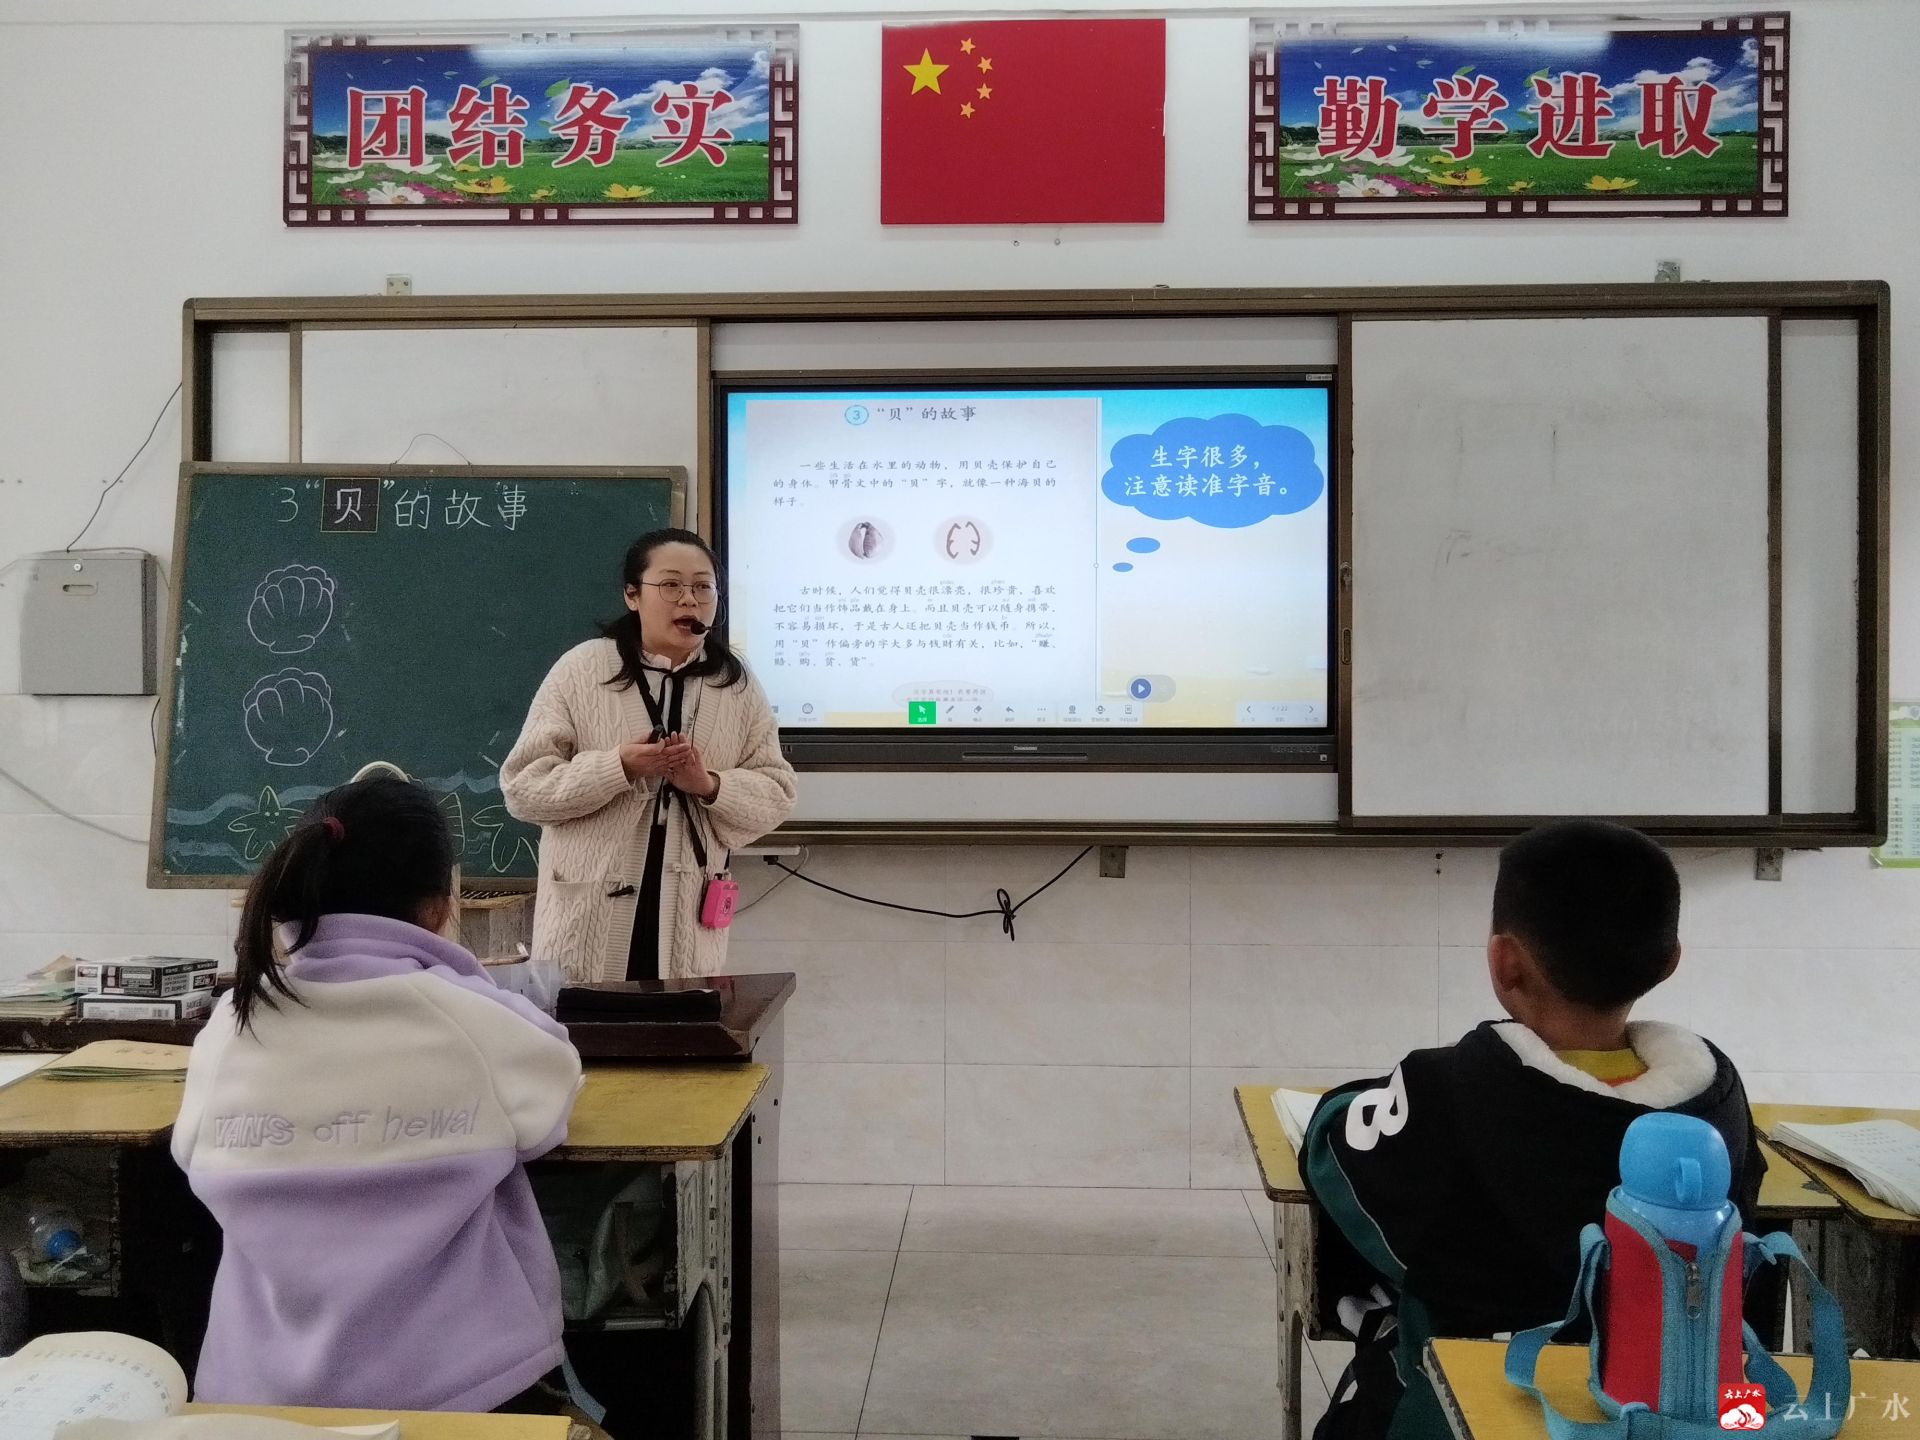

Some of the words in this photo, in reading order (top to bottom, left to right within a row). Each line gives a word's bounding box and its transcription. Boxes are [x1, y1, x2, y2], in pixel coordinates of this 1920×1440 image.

[346, 82, 735, 169] 团结务实
[1314, 72, 1723, 160] 勤学进取
[877, 406, 977, 422] “贝”的故事
[1150, 444, 1261, 470] 生字很多，
[1124, 472, 1288, 498] 注意读准字音。
[214, 1113, 296, 1148] VANS
[313, 1109, 371, 1144] off
